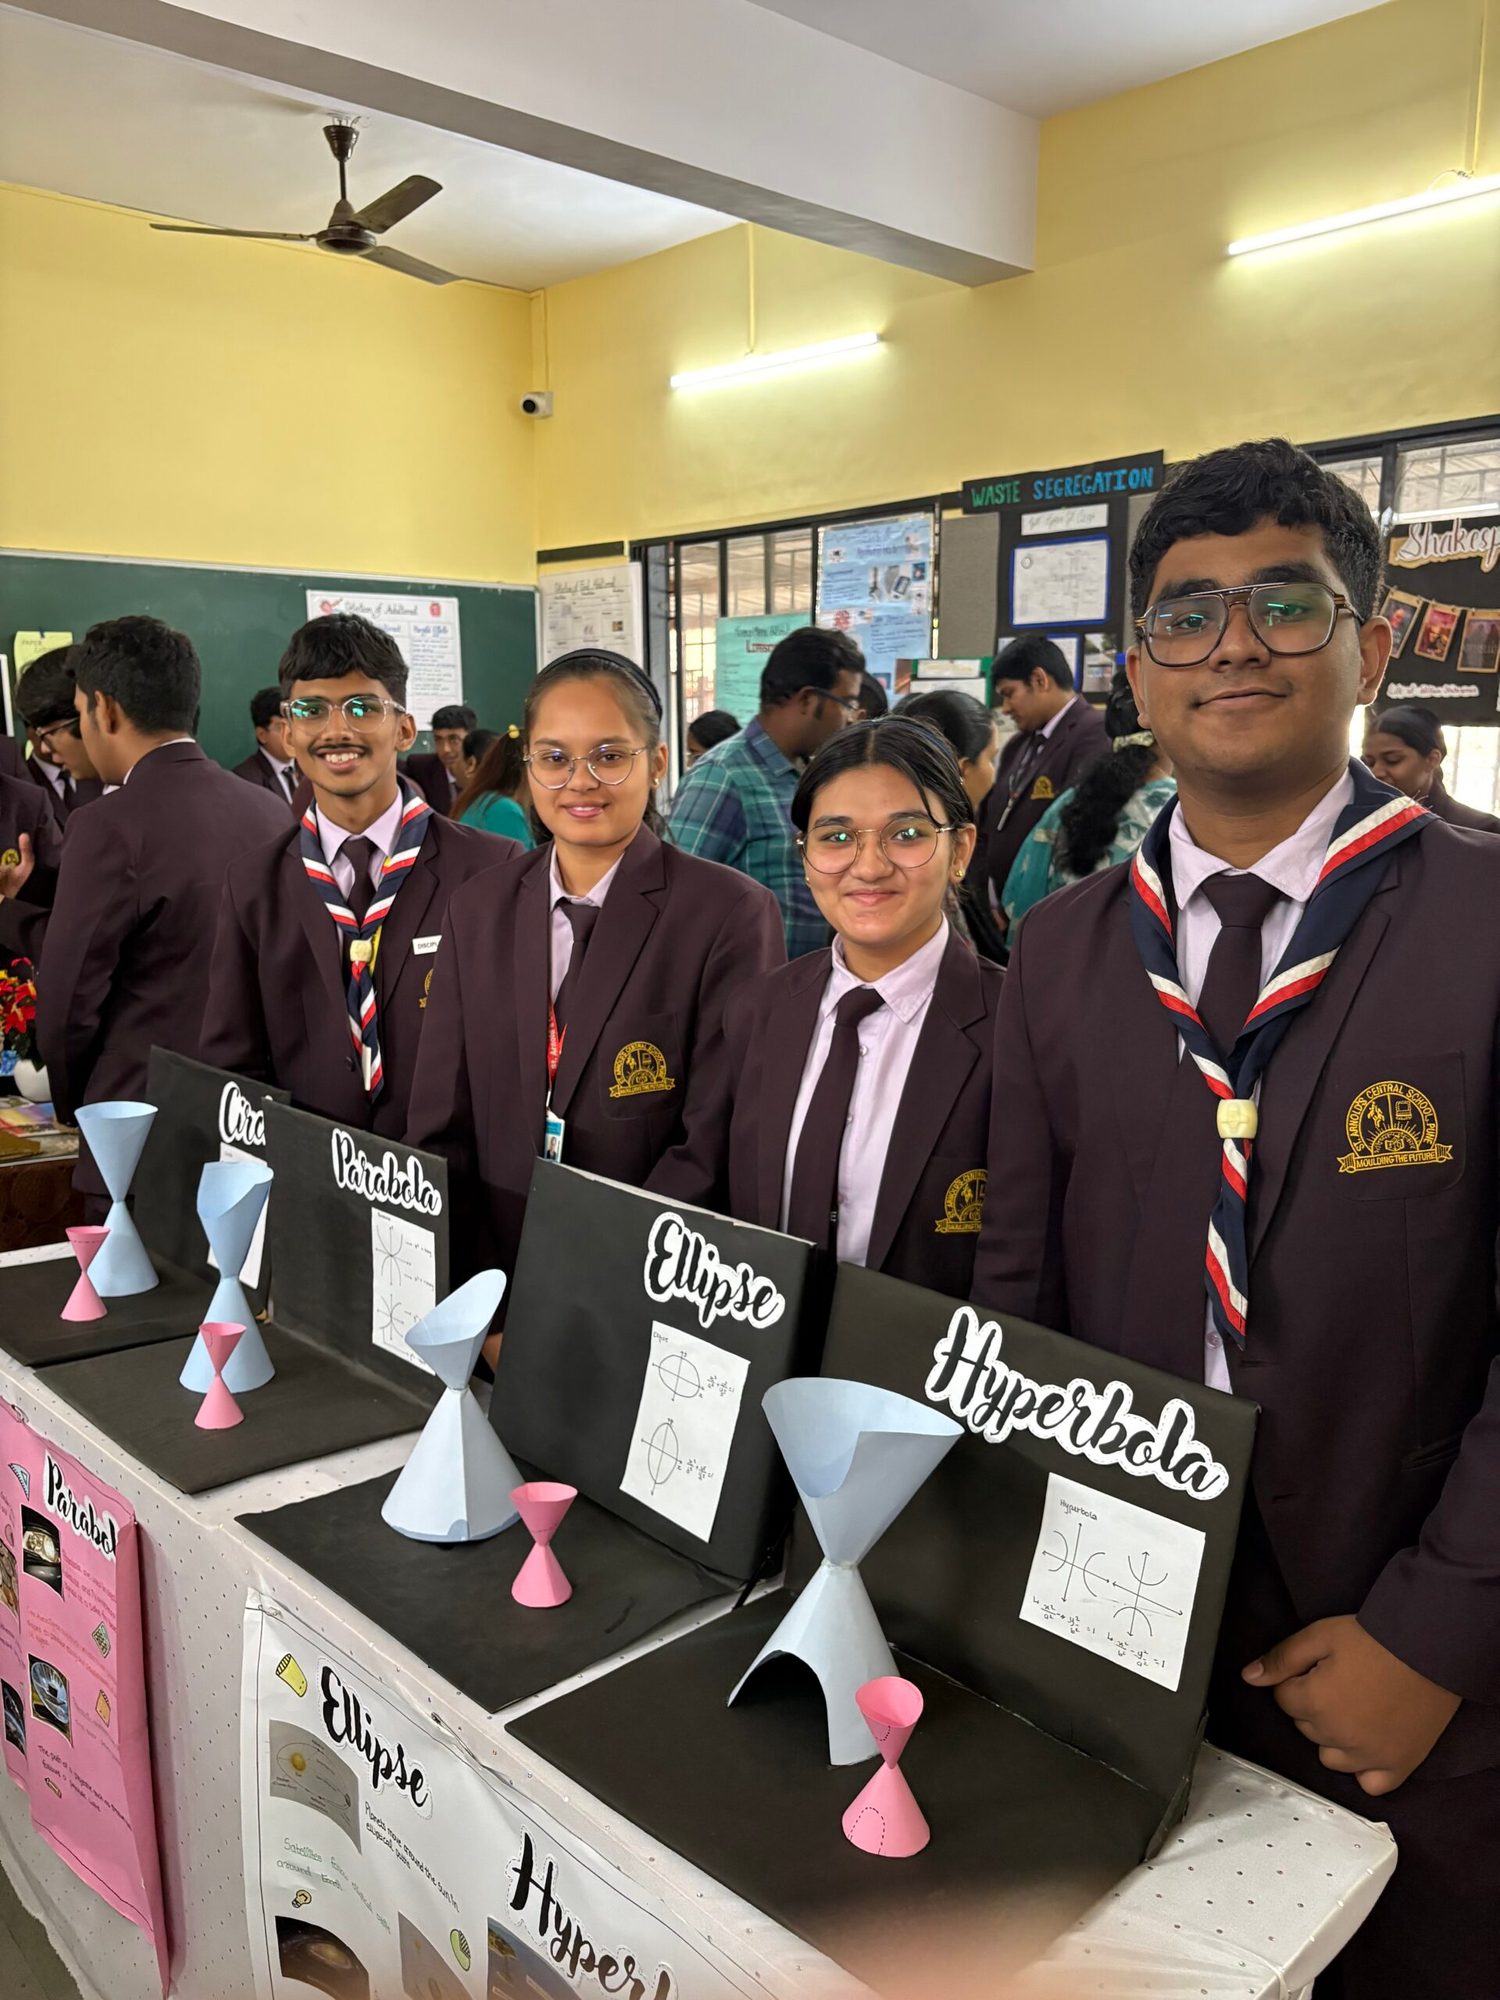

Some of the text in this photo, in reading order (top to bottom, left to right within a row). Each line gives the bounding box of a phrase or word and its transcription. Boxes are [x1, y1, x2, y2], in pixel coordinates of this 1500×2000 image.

[971, 467, 1154, 508] WASTE SEGREGATION
[1366, 1083, 1404, 1099] CENTRAL
[336, 1132, 439, 1211] Parabola
[1356, 1152, 1435, 1168] MOULDING THE FUTURE
[649, 1218, 779, 1323] Ellipse
[931, 1312, 1221, 1493] Hyperbola
[1060, 1499, 1098, 1521] Hyperbola
[321, 1665, 429, 1808] Ellipse
